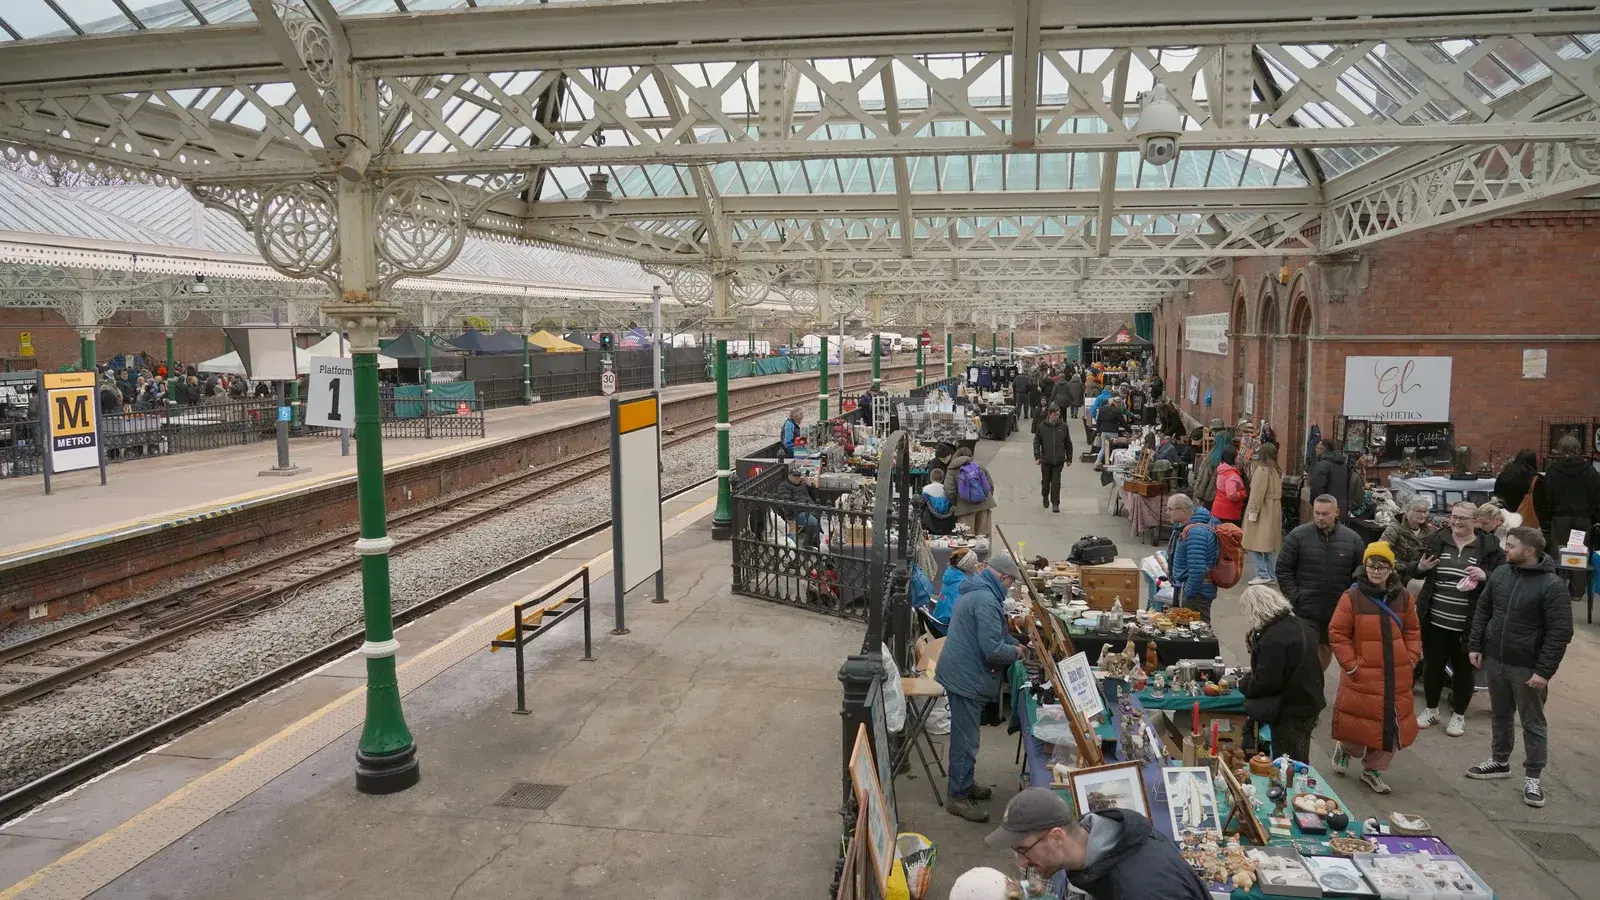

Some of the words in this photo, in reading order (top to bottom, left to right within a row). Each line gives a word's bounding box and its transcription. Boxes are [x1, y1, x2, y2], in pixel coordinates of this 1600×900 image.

[319, 365, 352, 375] Platform
[603, 374, 614, 384] 30
[1374, 359, 1421, 407] Gl
[328, 377, 341, 421] 1
[55, 395, 89, 430] M
[1373, 411, 1422, 420] ESTHETICS
[57, 435, 91, 448] METRO
